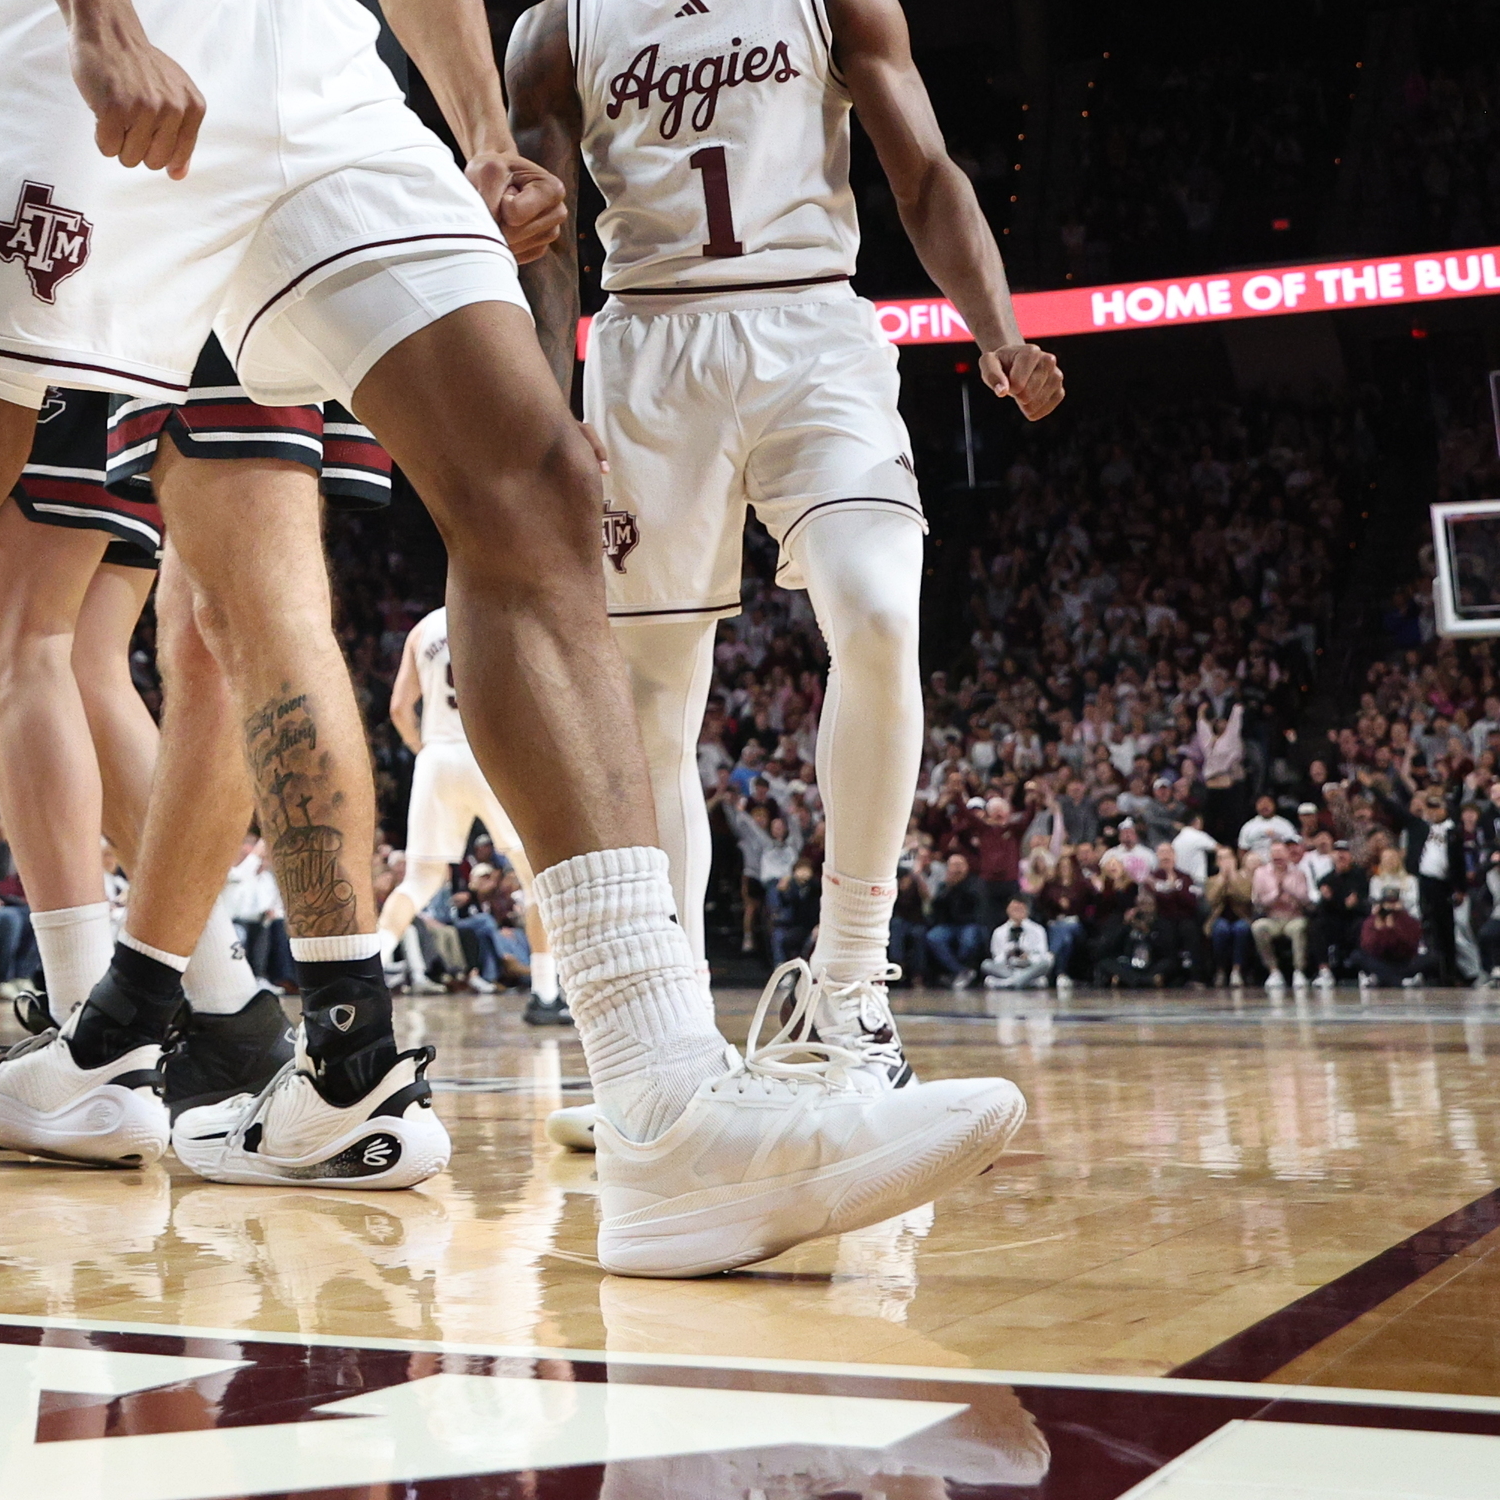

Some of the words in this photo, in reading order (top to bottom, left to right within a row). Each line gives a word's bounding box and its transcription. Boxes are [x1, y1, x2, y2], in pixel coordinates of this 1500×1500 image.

[606, 37, 800, 140] Aggies
[690, 146, 744, 257] 1
[876, 303, 970, 341] OFIN
[1091, 279, 1233, 327] HOME
[1242, 272, 1307, 311] OF
[1315, 263, 1405, 304] THE
[1414, 253, 1500, 296] BUL
